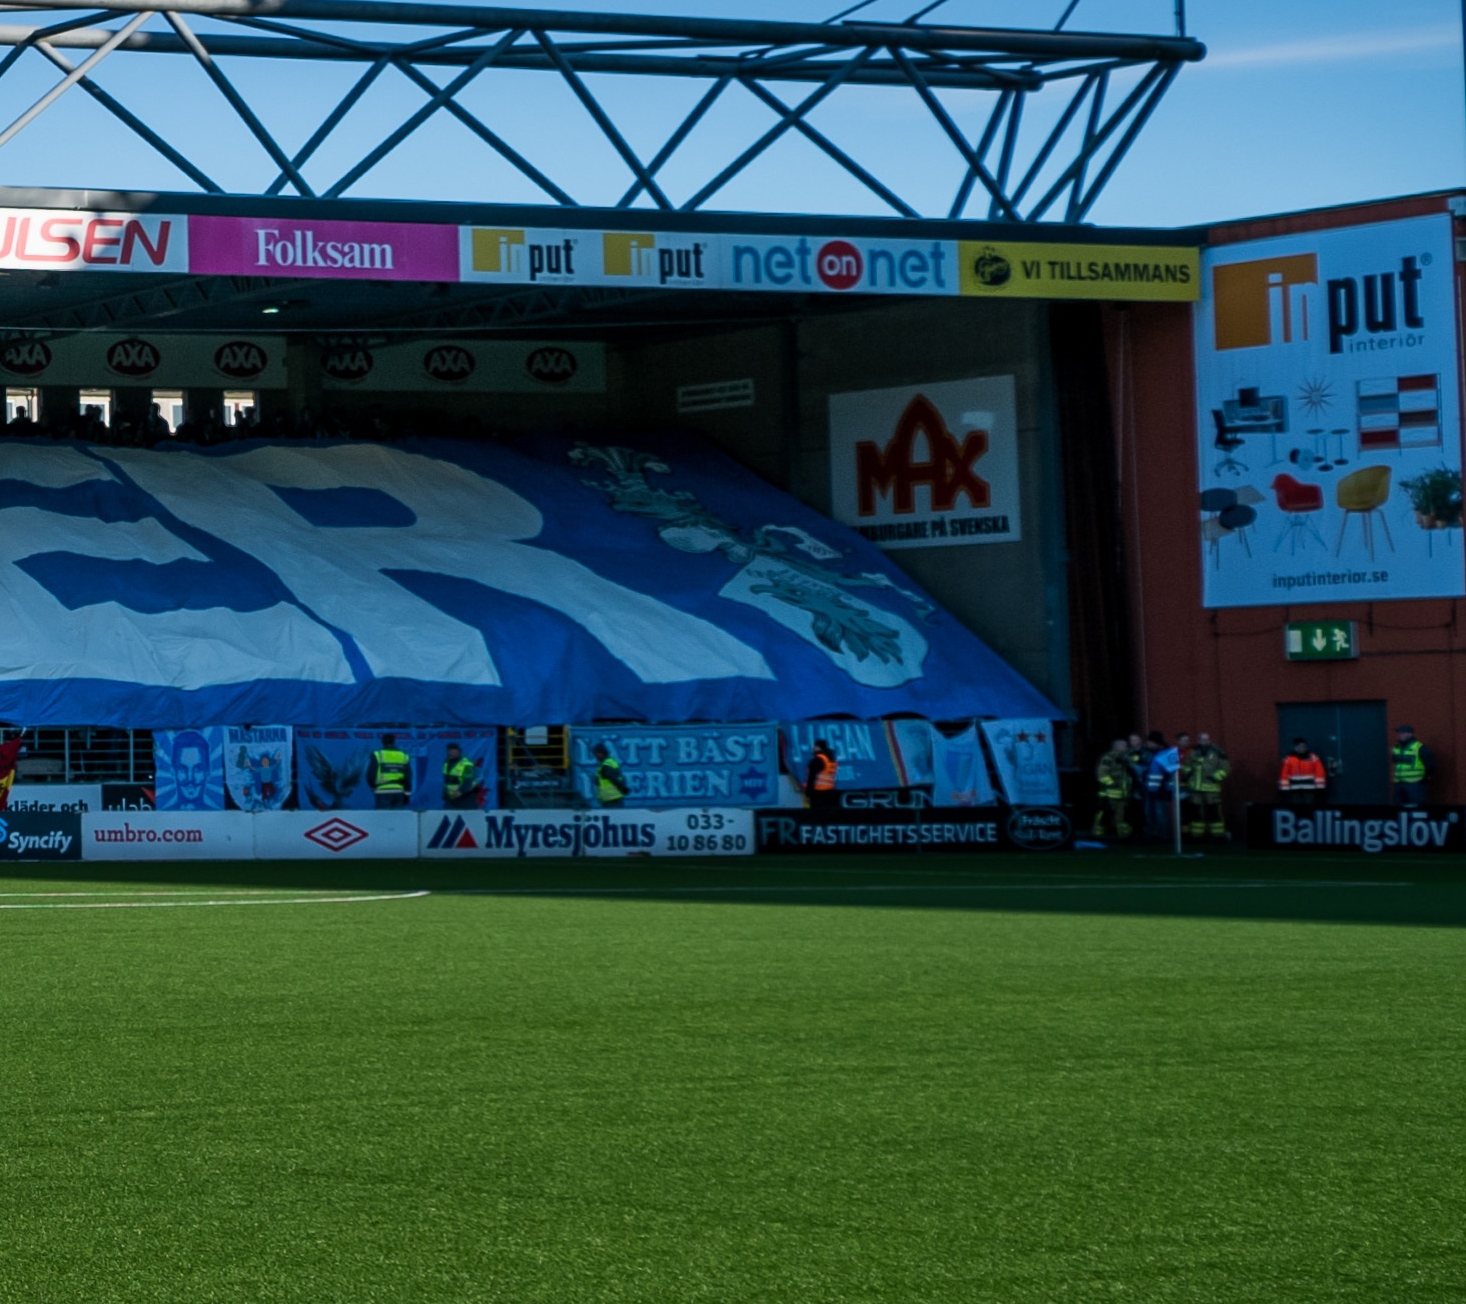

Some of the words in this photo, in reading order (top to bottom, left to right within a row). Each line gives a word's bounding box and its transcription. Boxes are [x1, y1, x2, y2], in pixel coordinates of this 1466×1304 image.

[254, 229, 394, 270] Folksam
[733, 237, 811, 285] net
[821, 253, 857, 277] on
[870, 242, 945, 289] net
[1022, 261, 1041, 280] VI
[1046, 261, 1191, 284] TILLSAMMANS
[1350, 334, 1425, 353] interiör
[218, 346, 262, 370] AXA
[530, 351, 573, 375] AXA
[856, 394, 991, 516] MAX
[854, 521, 930, 542] MBURGARE
[931, 516, 947, 538] PÅ
[951, 515, 1010, 537] SVENSKA
[676, 731, 769, 763] BÄST
[622, 770, 731, 797] ERIEN
[8, 829, 72, 854] Syncify
[94, 822, 204, 843] umbro.com
[485, 815, 655, 857] Myresjöhus
[668, 834, 691, 851] 10
[694, 834, 718, 851] 86
[723, 834, 747, 851] 80
[759, 817, 800, 846] FR
[801, 823, 998, 845] FASTIGHETSSERVICE
[1273, 809, 1451, 853] Ballingslöv
